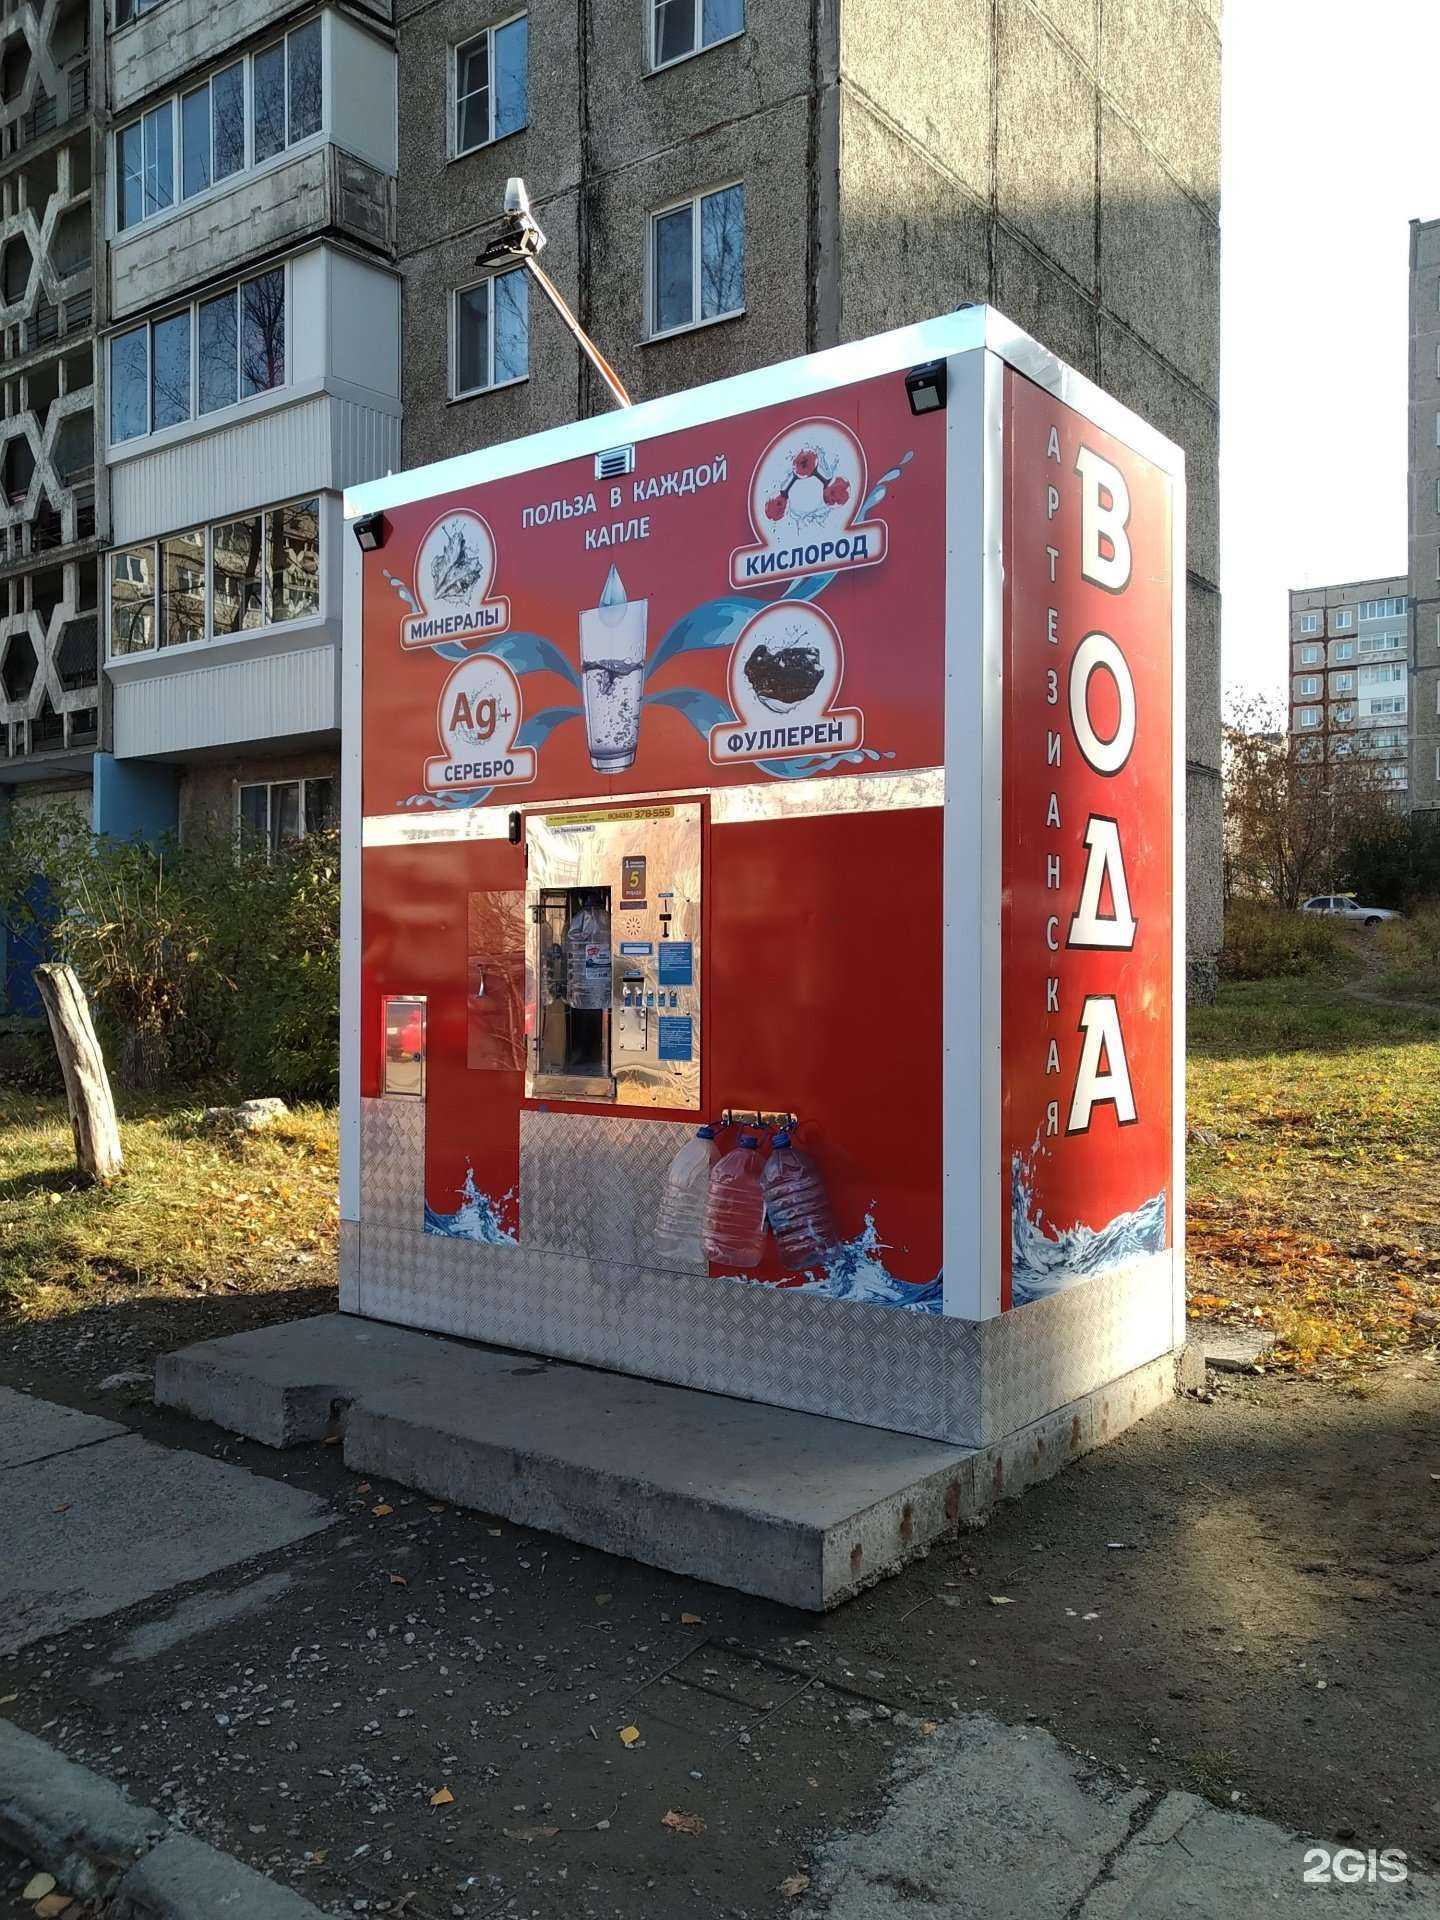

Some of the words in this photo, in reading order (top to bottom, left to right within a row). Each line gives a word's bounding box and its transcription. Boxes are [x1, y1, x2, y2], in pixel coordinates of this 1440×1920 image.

[522, 493, 597, 528] ПОЛЬЗА
[610, 487, 621, 508] В
[633, 454, 728, 502] КАЖДОЙ
[585, 516, 650, 550] КАПЛЕ
[746, 534, 869, 576] КИСЛОРОД
[411, 608, 499, 640] МИНЕРАЛЫ
[727, 721, 843, 752] ФУЛЛЕРЕН
[444, 759, 514, 782] СЕРЕБРО
[1046, 424, 1061, 1138] АРТЕЗИАНСКАЯ
[1066, 442, 1138, 1134] ВОДА
[634, 807, 671, 819] 378-555
[629, 870, 640, 888] 5
